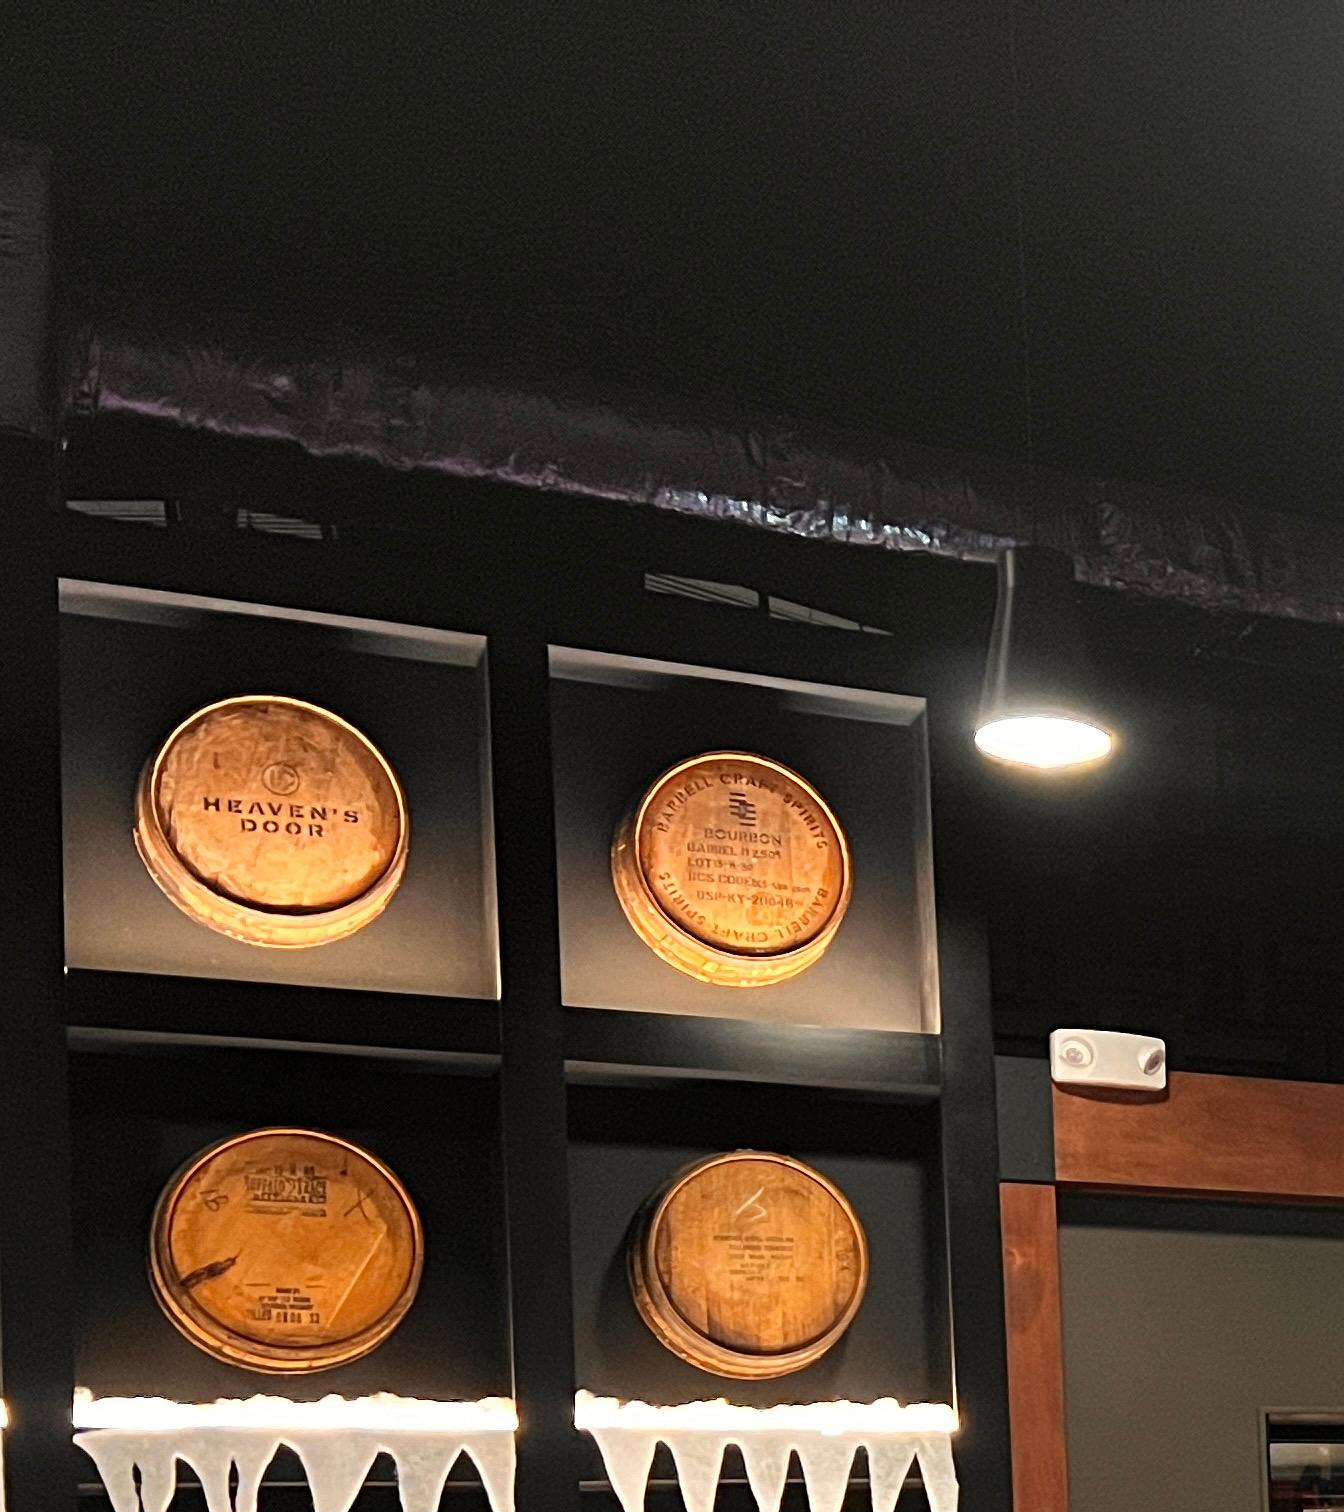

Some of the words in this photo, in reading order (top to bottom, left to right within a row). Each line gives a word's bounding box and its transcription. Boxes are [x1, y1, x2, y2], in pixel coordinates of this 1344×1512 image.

[203, 797, 360, 824] HEAVEN'S
[783, 793, 828, 849] SPIRITS
[240, 818, 324, 838] DOOR
[704, 828, 782, 847] BOURBON
